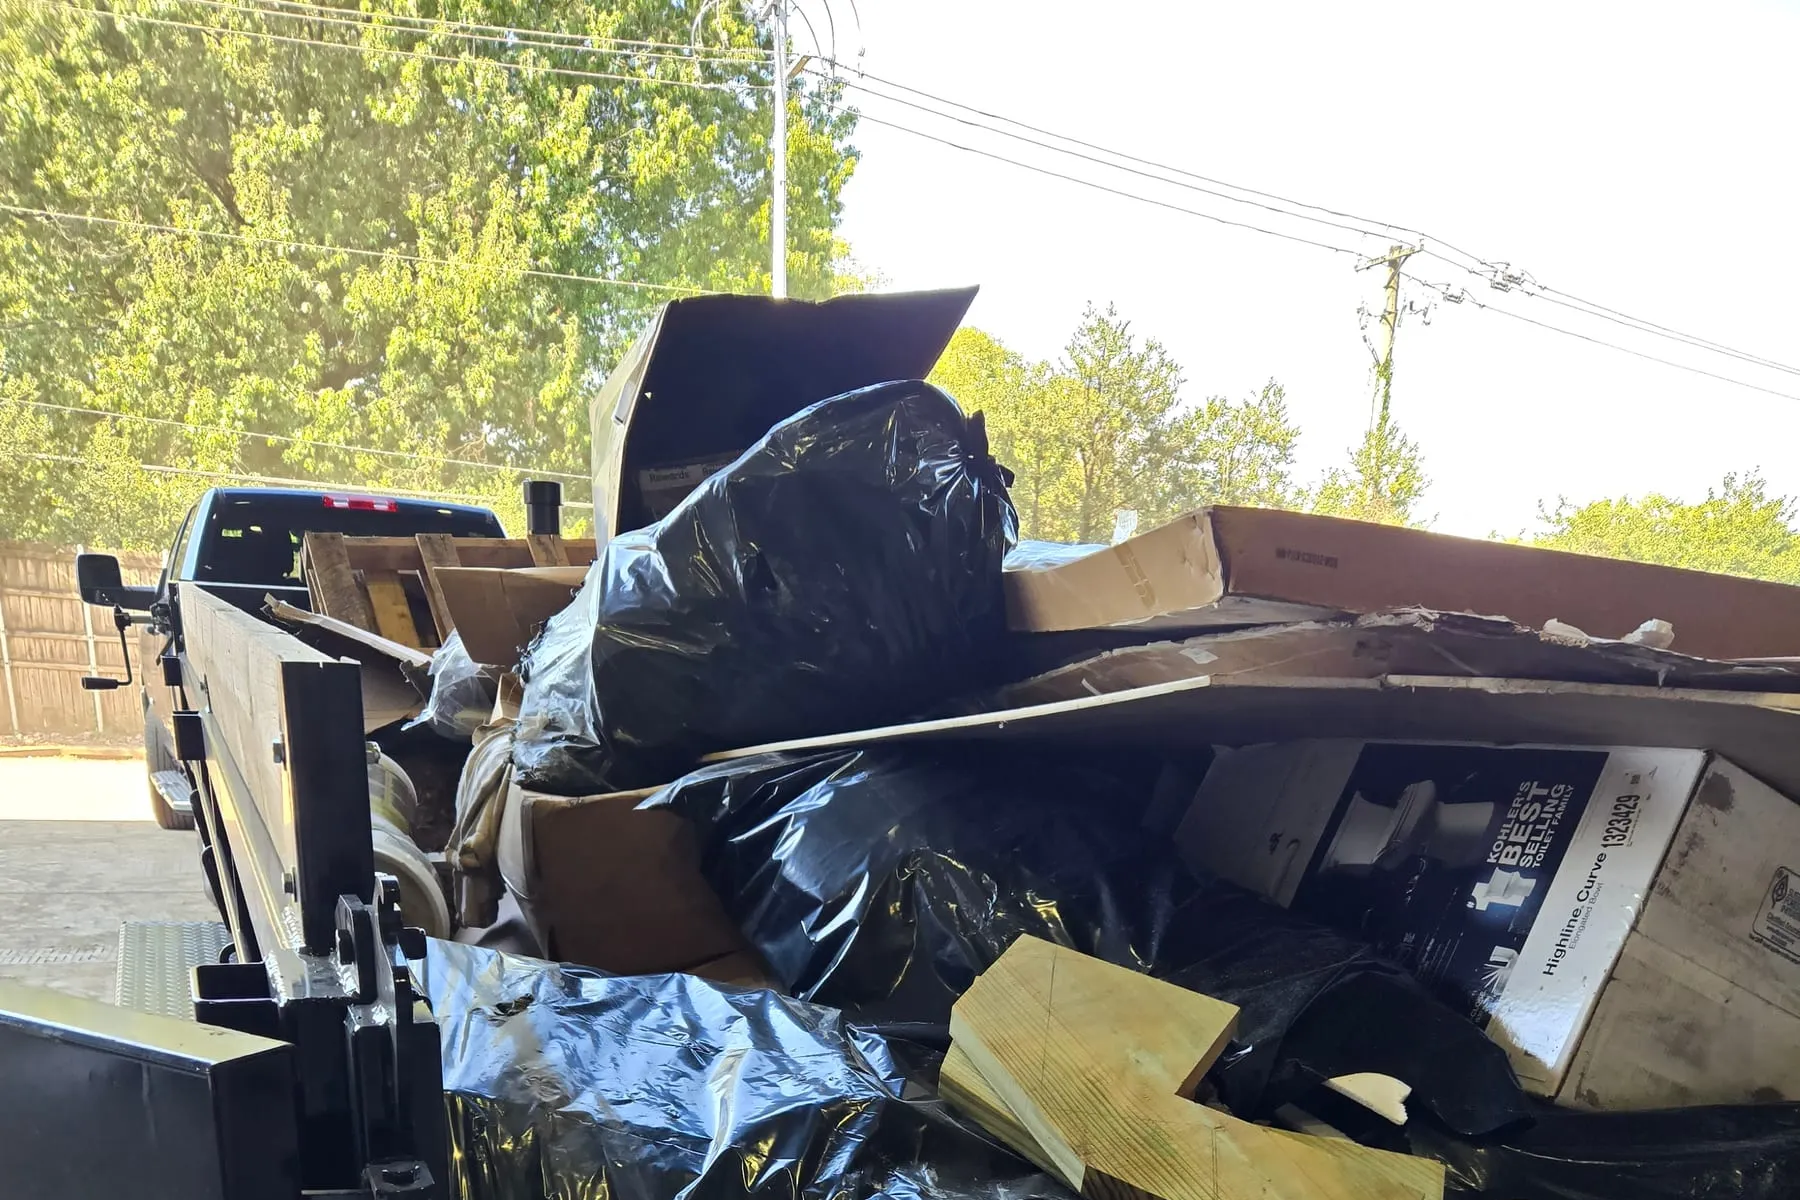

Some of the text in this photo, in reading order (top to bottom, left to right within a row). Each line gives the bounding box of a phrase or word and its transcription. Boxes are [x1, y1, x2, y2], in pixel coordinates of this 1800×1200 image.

[1487, 781, 1531, 863] KOHLER'S
[1498, 781, 1549, 866] BEST
[1519, 784, 1566, 868] SELLING
[1532, 785, 1574, 868] TOILET FAMILY
[1601, 795, 1640, 848] 1323429
[1543, 852, 1607, 976] Highline Curve
[1568, 882, 1605, 950] Elongated Bowl
